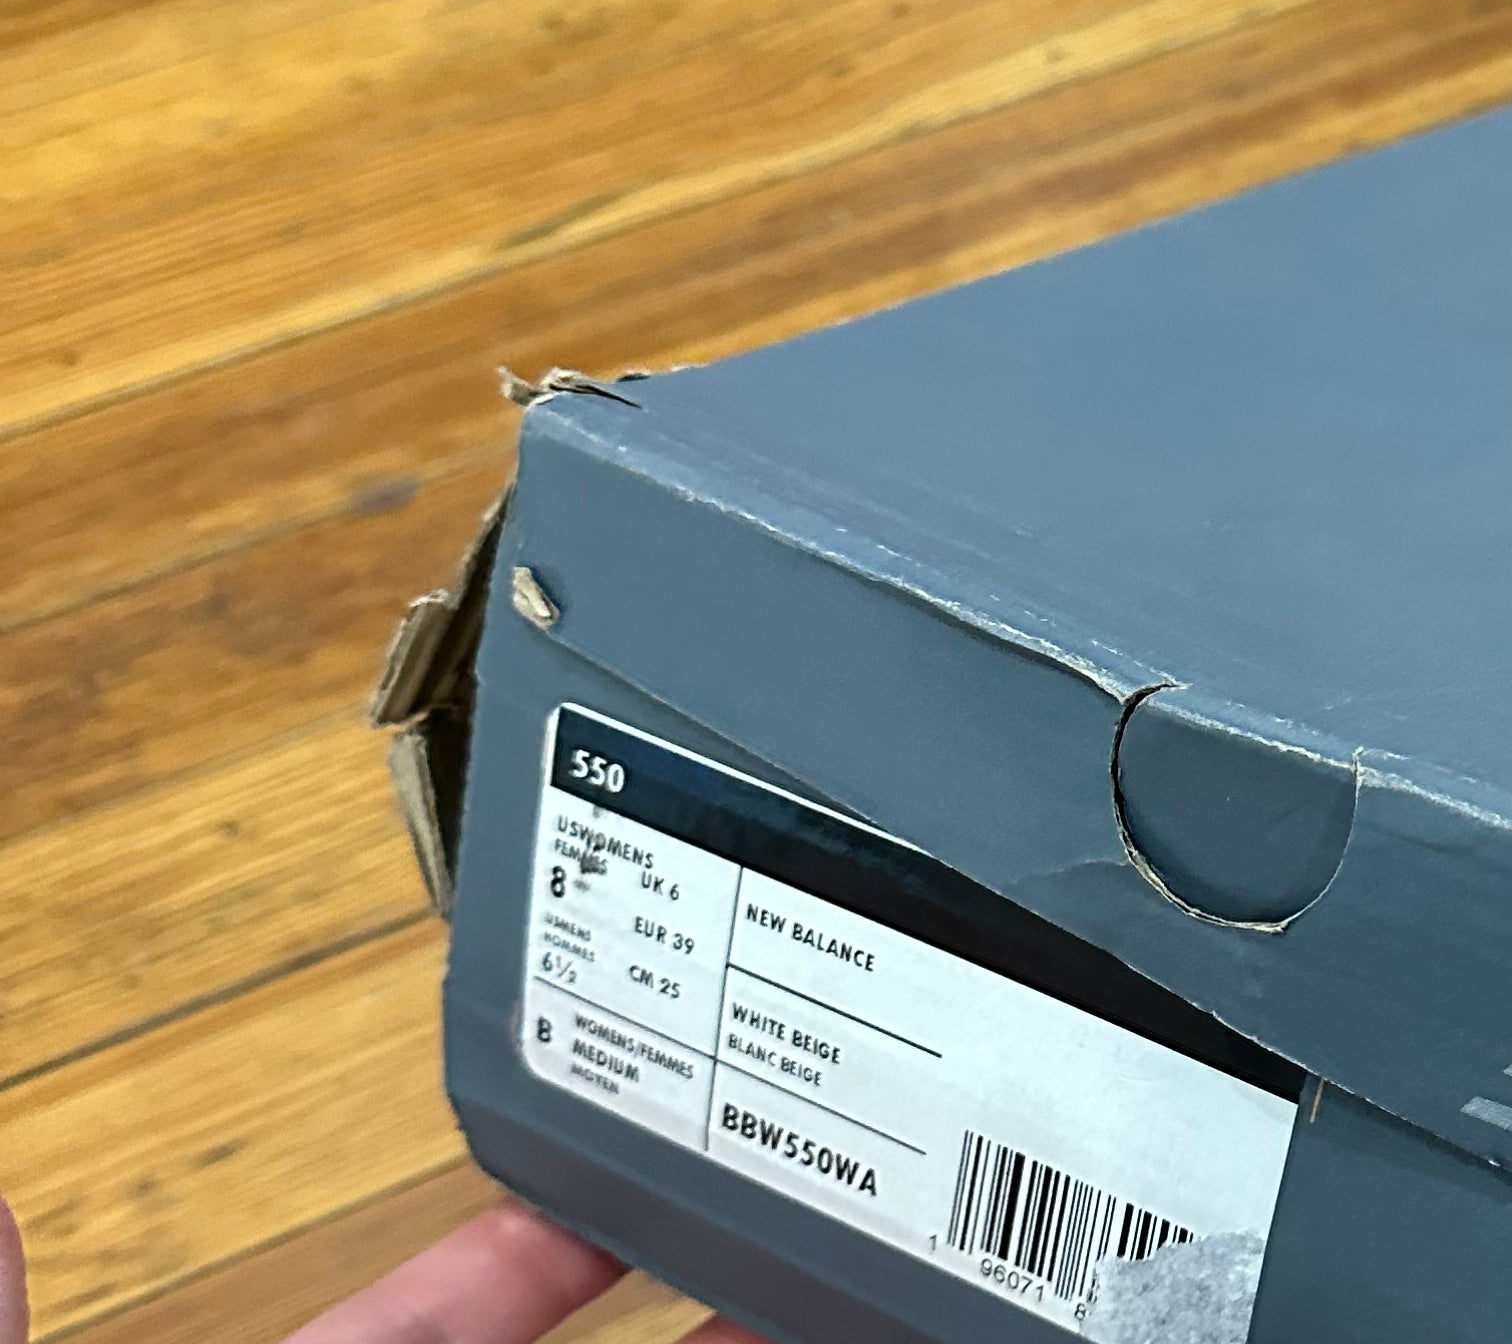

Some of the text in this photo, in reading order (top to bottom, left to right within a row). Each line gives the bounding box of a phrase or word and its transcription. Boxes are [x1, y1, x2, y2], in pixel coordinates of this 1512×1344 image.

[569, 748, 625, 793] 550
[550, 865, 567, 898] 8
[641, 871, 680, 901] UK 6
[544, 931, 596, 962] HOMMES
[634, 916, 695, 955] EUR 39
[746, 903, 875, 972] NEW BALANCE
[629, 965, 681, 999] CM 25
[574, 1012, 694, 1079] WOMENS/FEMMES
[732, 1002, 841, 1065] WHITE BEIGE
[570, 1063, 620, 1094] MOYEN
[572, 1038, 640, 1083] MEDIUM
[728, 1033, 823, 1087] BLANC BEIGE
[721, 1103, 878, 1198] BBW550WA
[928, 1234, 938, 1255] 1
[980, 1258, 1045, 1302] 96071
